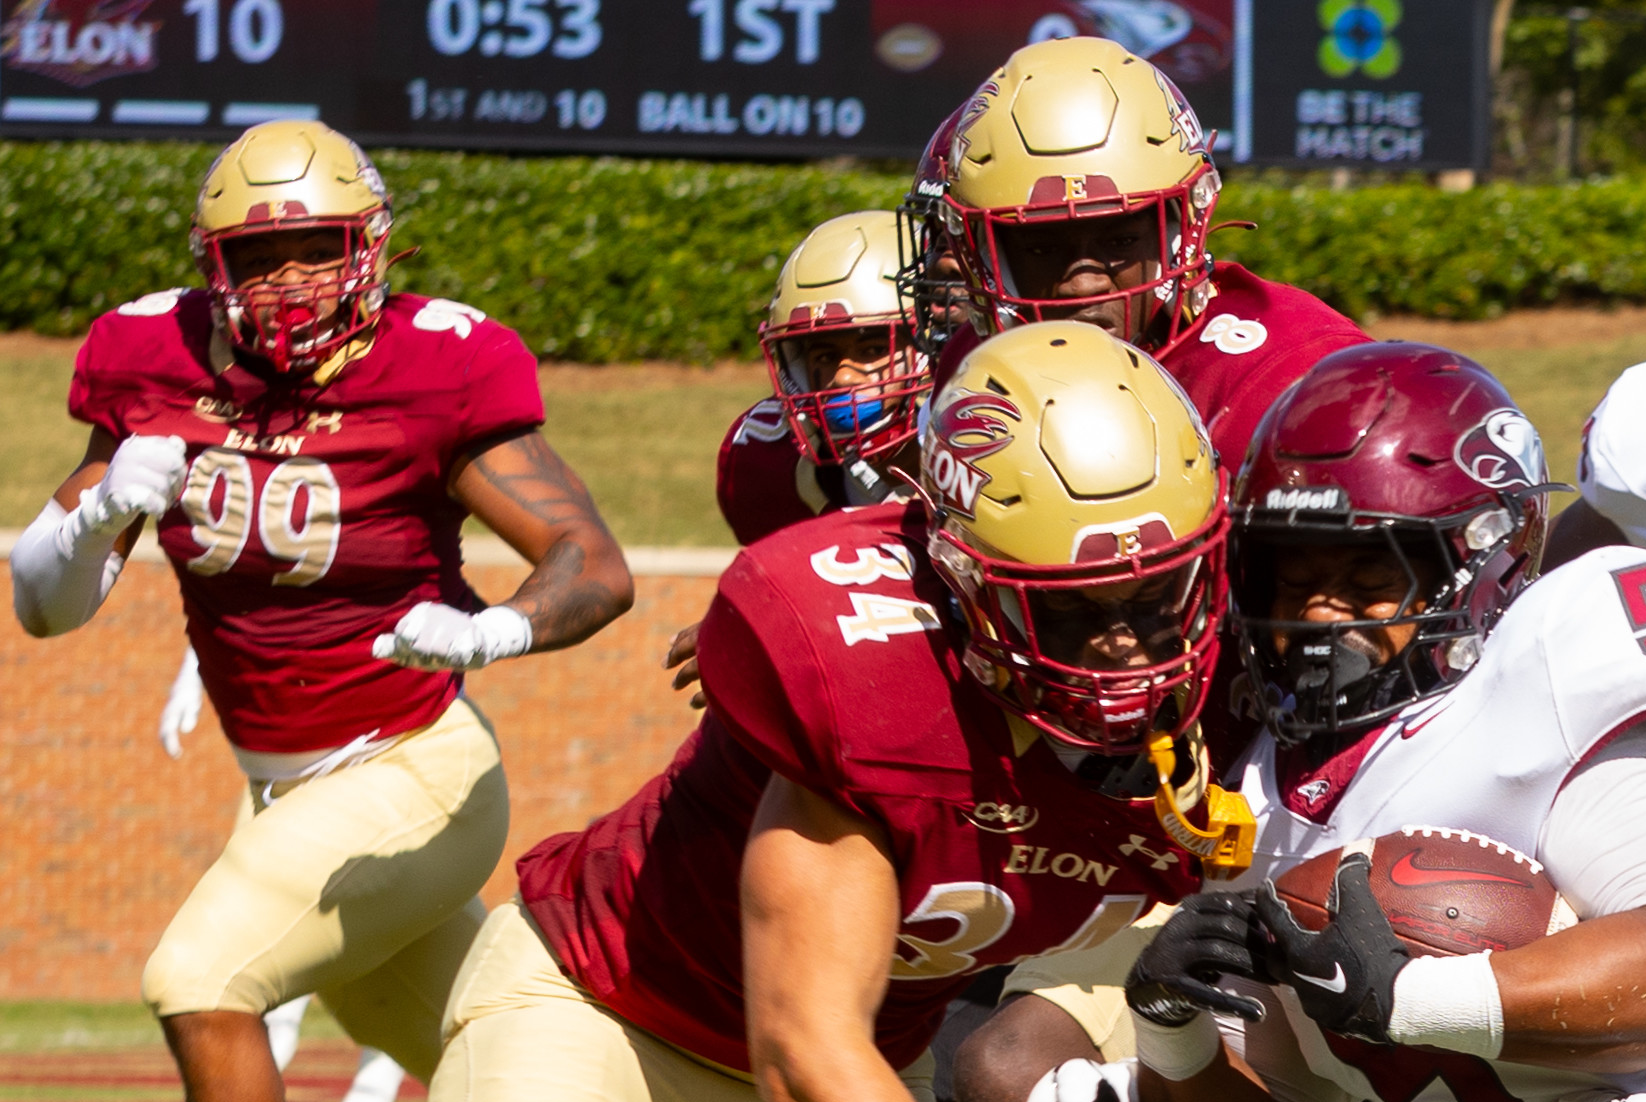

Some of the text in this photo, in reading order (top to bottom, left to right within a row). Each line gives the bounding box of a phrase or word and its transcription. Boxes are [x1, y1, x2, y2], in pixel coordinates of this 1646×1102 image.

[18, 20, 153, 66] ELON
[183, 0, 284, 64] 10
[427, 0, 603, 60] 0:53
[688, 0, 838, 65] 1ST
[406, 77, 607, 130] 1ST AND 10
[638, 90, 865, 139] BALL ON 10
[1296, 88, 1423, 128] BE THE
[1295, 124, 1423, 162] MATCH
[1061, 174, 1088, 201] E
[1199, 313, 1268, 355] 8
[222, 427, 306, 457] ELON
[181, 447, 342, 589] 99
[1266, 488, 1339, 510] Riddell
[809, 541, 944, 647] 34
[973, 800, 1031, 825] CAA
[1003, 842, 1120, 888] ELON
